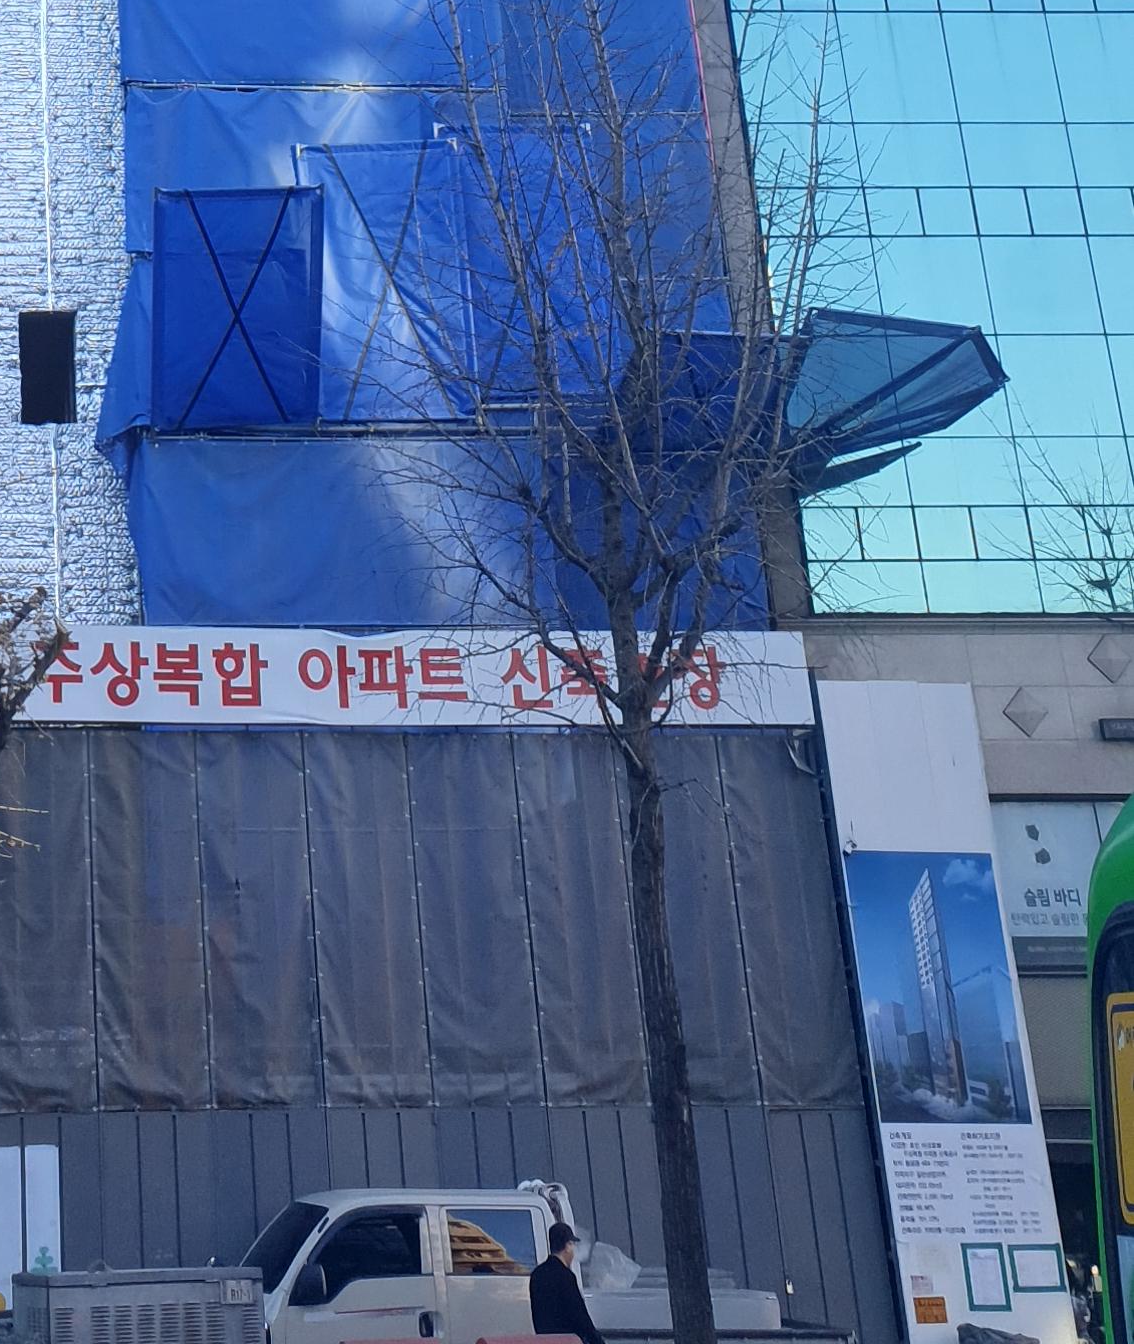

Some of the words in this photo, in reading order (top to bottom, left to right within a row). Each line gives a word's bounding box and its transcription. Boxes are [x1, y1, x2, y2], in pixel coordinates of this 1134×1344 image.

[35, 640, 269, 709] 주상복합
[298, 645, 468, 710] 아파트
[501, 645, 727, 710] 신축장
[1024, 888, 1051, 907] 슬림
[1054, 888, 1082, 908] 바디
